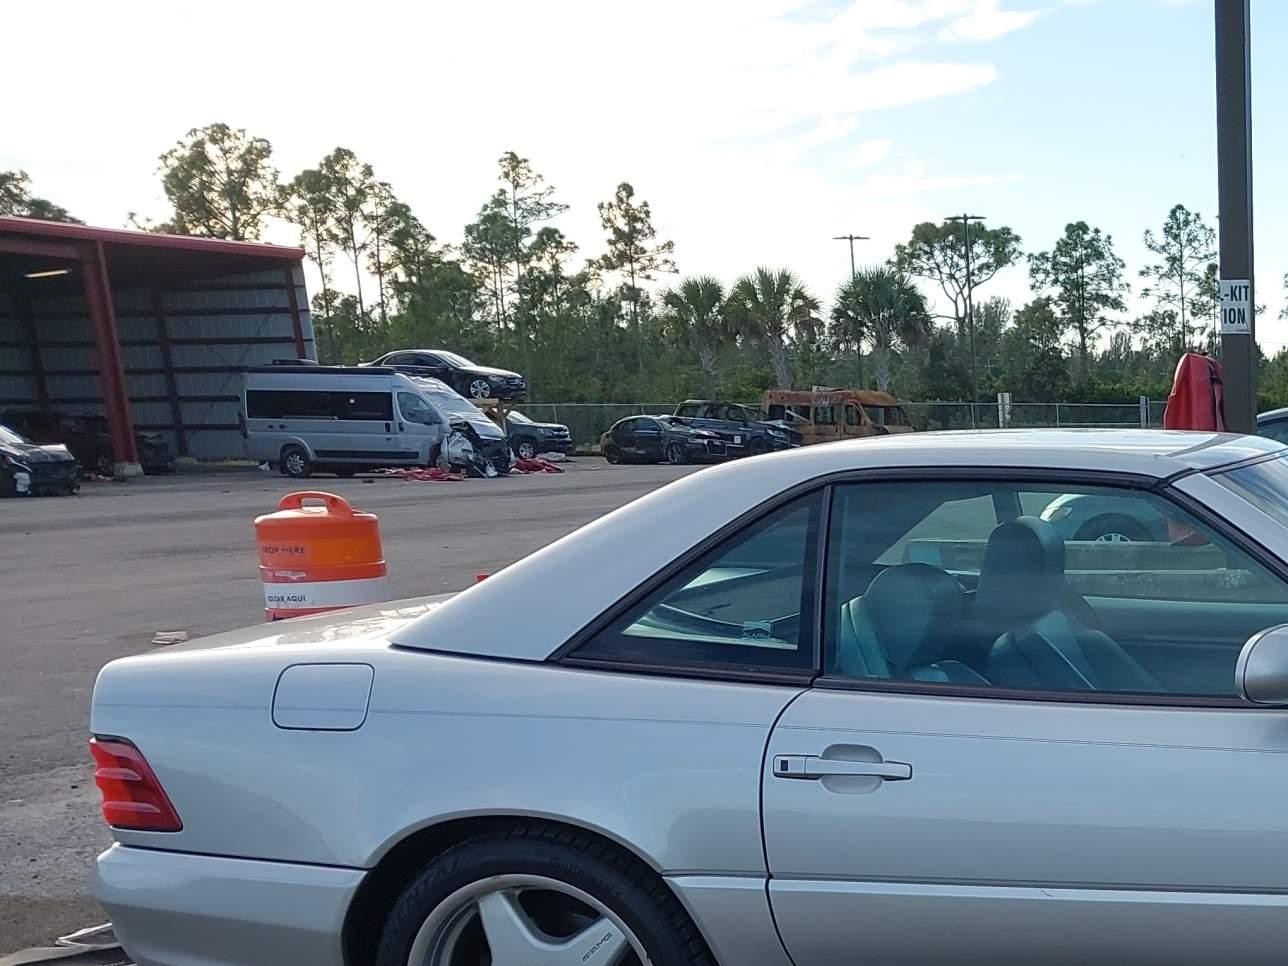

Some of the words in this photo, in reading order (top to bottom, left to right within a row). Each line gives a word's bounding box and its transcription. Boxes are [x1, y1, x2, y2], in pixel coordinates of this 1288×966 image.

[1220, 285, 1250, 302] -KIT
[1221, 307, 1247, 325] ION
[286, 594, 307, 602] AQUI
